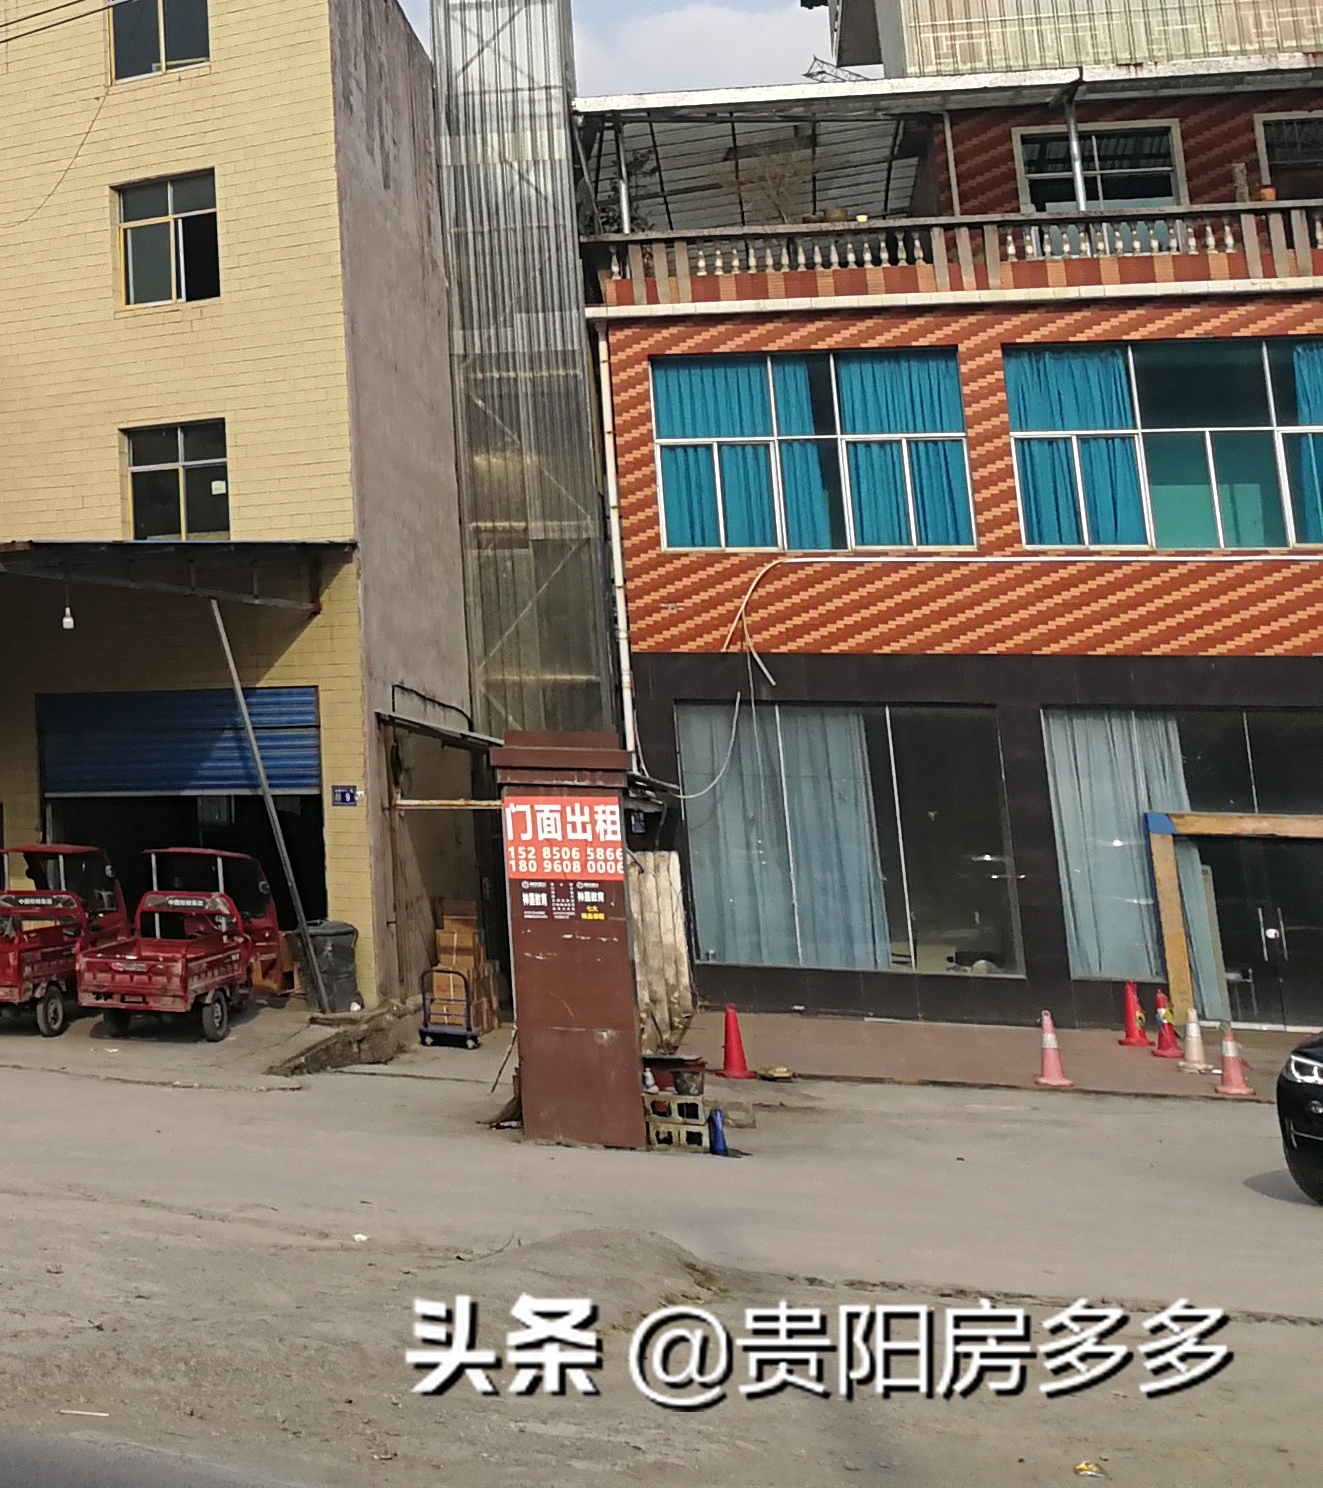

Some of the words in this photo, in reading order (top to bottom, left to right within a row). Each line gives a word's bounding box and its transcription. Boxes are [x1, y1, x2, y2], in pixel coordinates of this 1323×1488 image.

[505, 802, 622, 842] 门面出租
[508, 846, 536, 860] 152
[542, 847, 581, 860] 8506
[509, 859, 538, 873] 180
[543, 860, 582, 873] 9608
